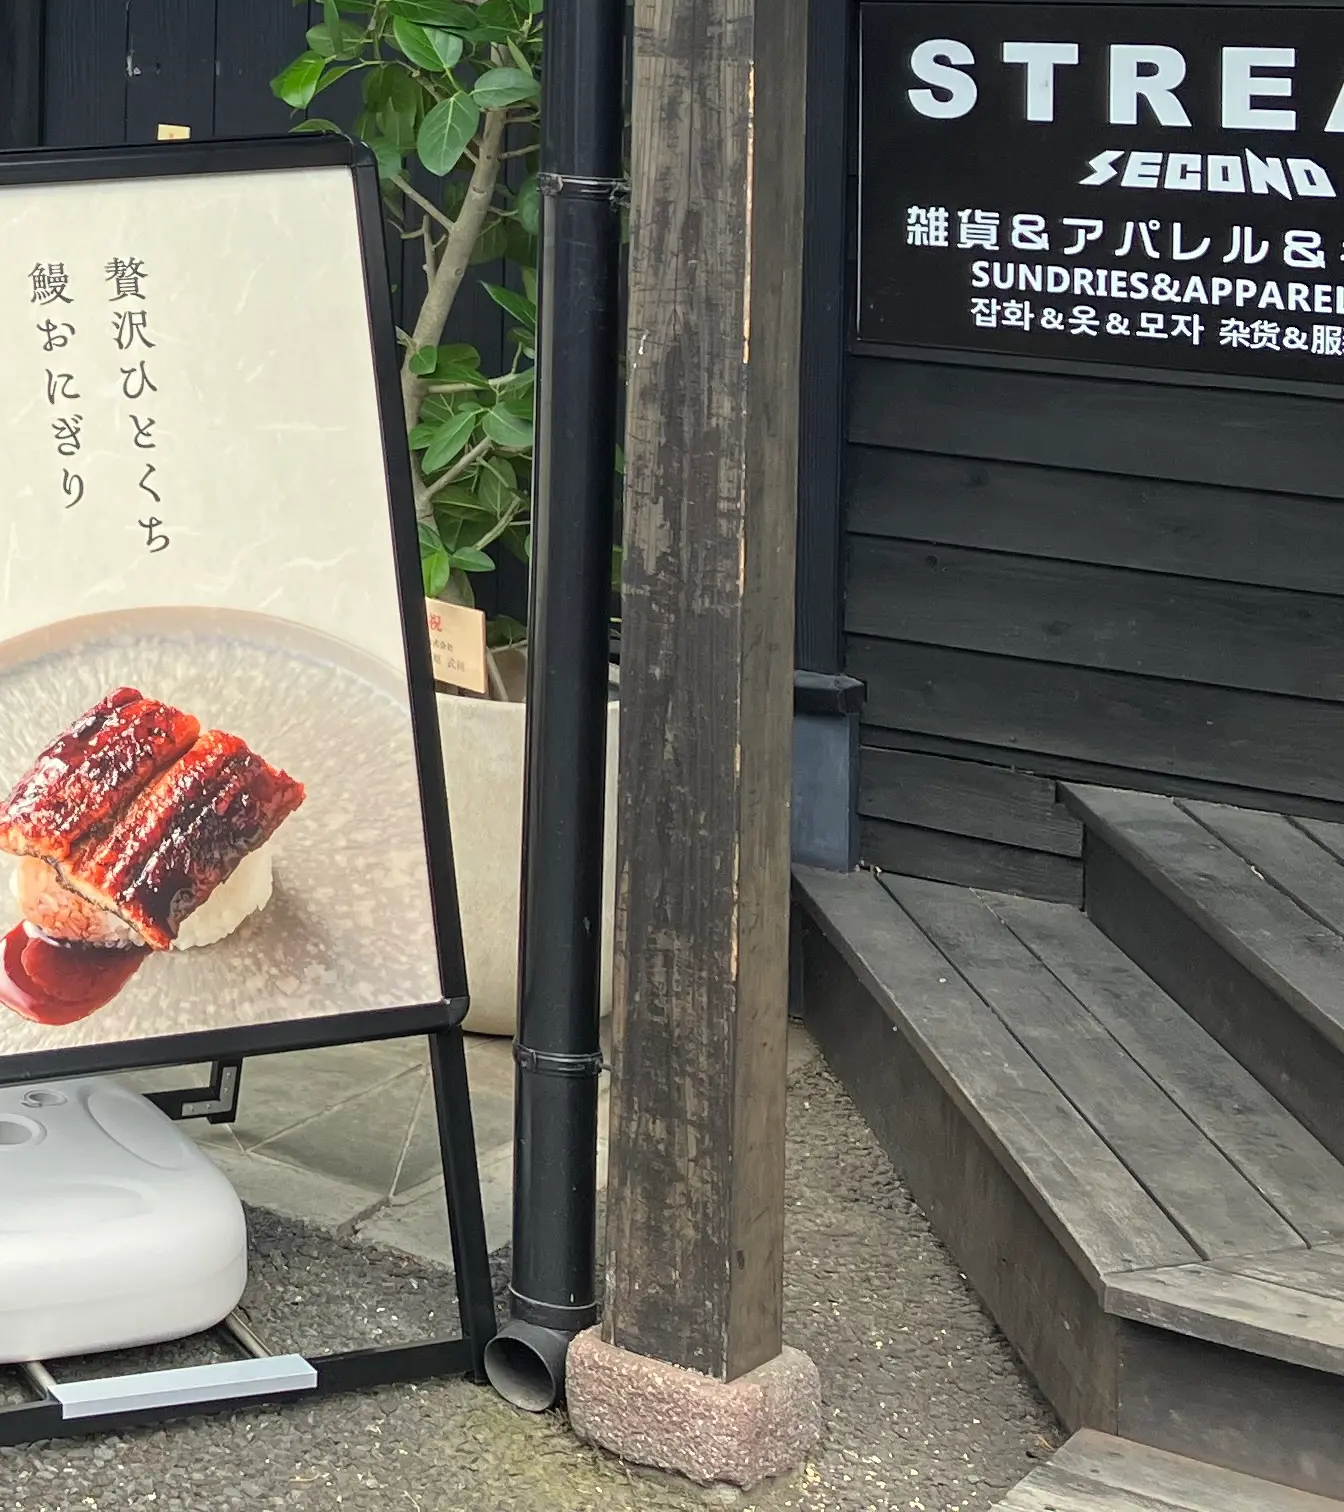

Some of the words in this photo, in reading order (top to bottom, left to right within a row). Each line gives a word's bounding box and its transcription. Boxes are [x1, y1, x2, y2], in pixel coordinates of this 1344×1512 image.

[1078, 148, 1337, 201] SECOND
[906, 204, 1344, 269] 雑貨&アパレル&
[1219, 316, 1344, 356] 杂货&服
[27, 261, 85, 509] 鰻おにぎり
[103, 255, 171, 554] 贅沢ひとくち
[429, 612, 443, 633] 祝
[432, 638, 454, 653] 式会社
